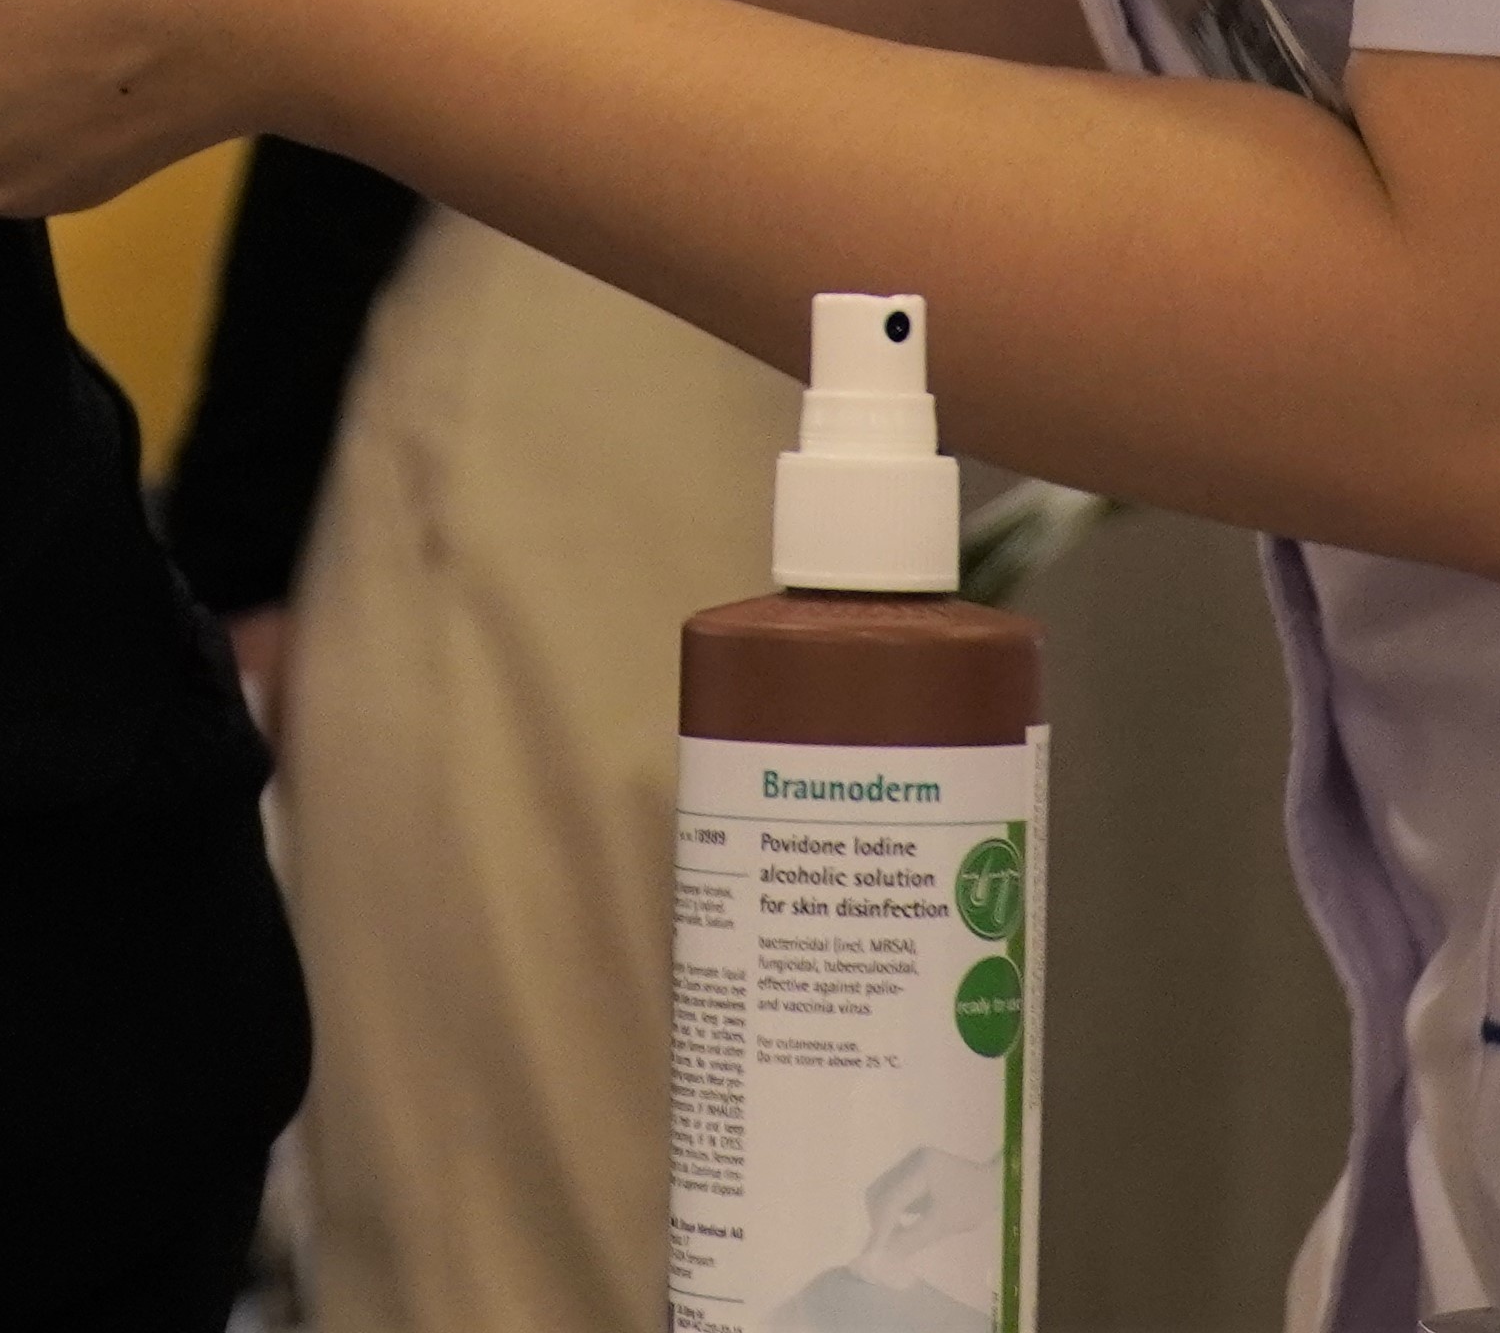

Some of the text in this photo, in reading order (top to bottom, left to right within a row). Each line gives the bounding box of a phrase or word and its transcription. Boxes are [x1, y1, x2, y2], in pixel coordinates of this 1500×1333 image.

[762, 769, 941, 803] Braunoderm
[760, 832, 917, 857] Povidone Iodine
[759, 864, 936, 888] alcoholic solution
[759, 893, 949, 918] for skin disinfection
[757, 935, 829, 952] bactericidal
[757, 975, 810, 992] effective
[813, 981, 862, 996] against
[757, 997, 778, 1011] and
[756, 1050, 771, 1064] Do
[827, 1055, 862, 1069] above
